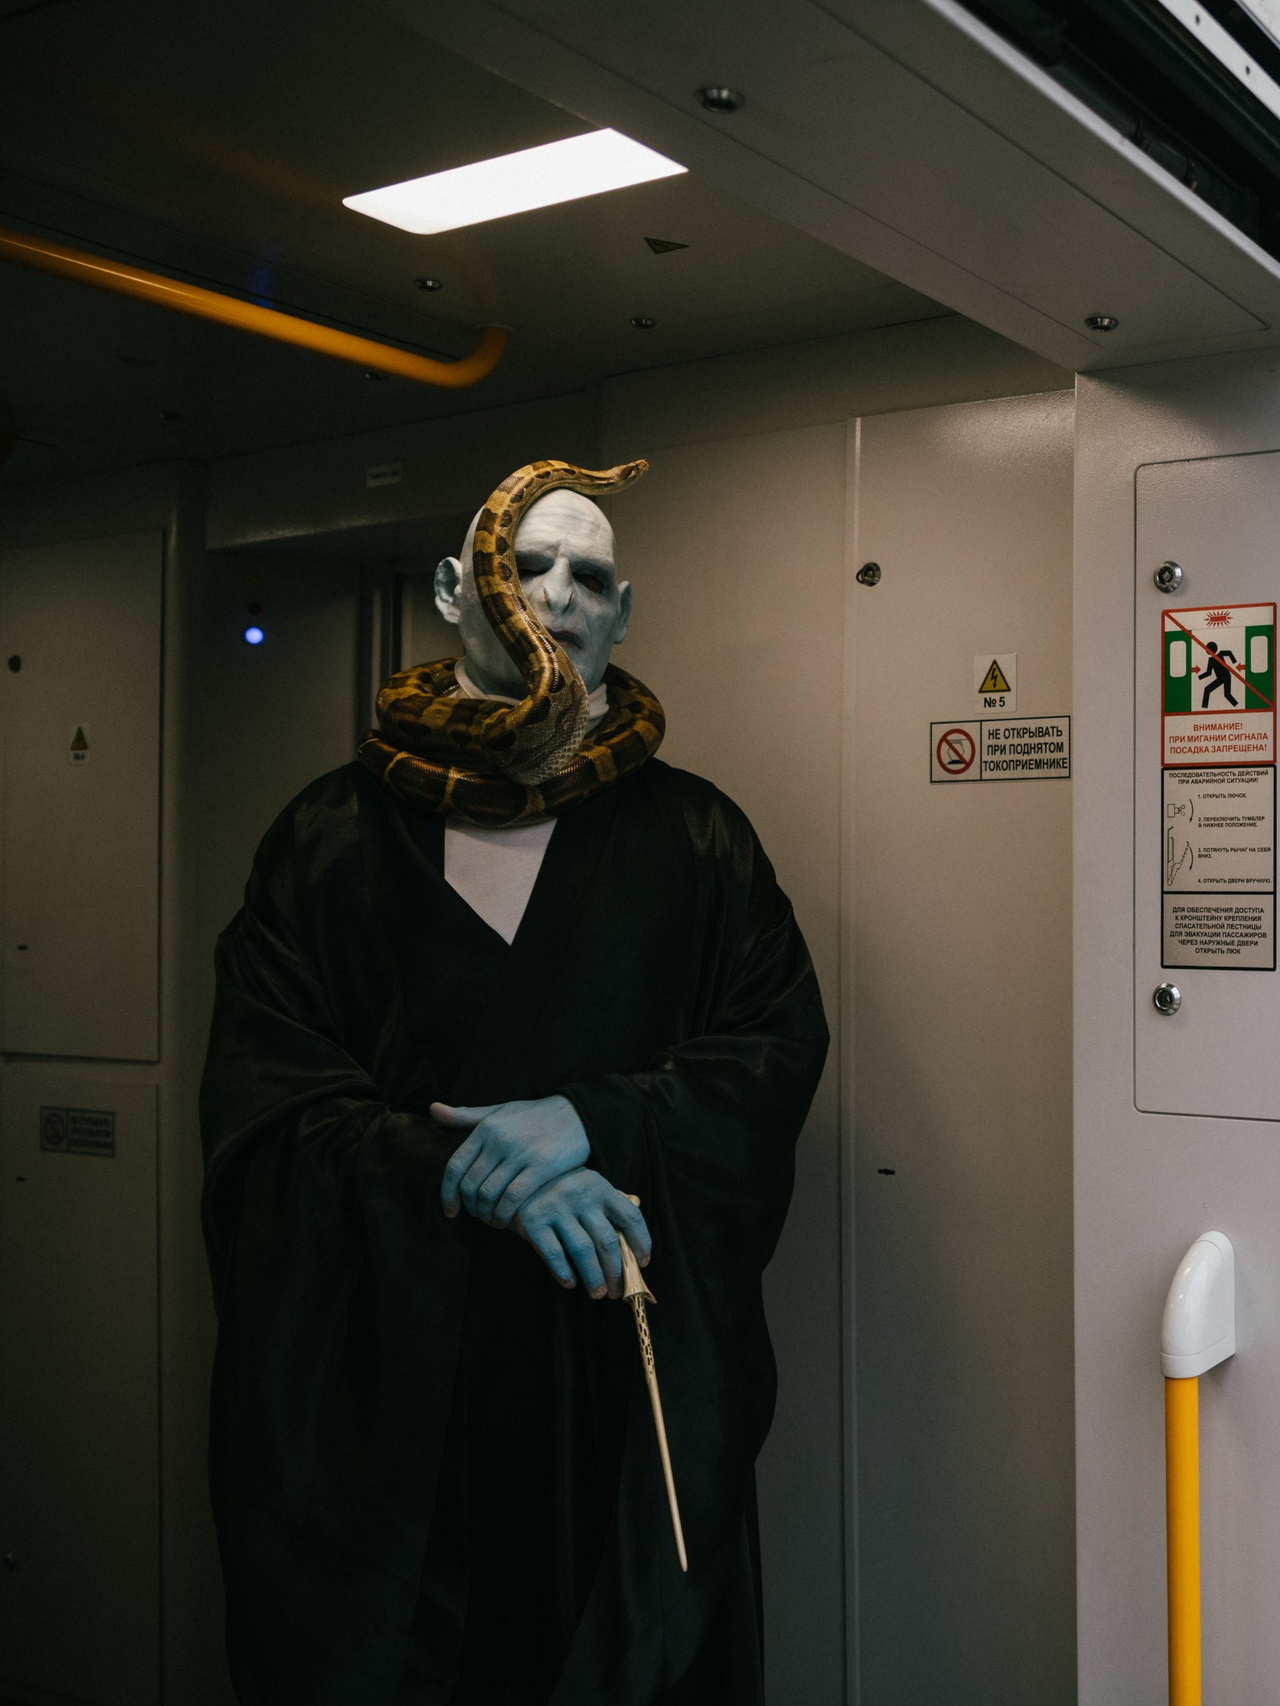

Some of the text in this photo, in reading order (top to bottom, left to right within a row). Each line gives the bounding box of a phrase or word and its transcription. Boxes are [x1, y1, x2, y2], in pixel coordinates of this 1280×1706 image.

[1194, 723, 1242, 731] ВНИМАНИЕ!
[988, 726, 1062, 740] НЕ ОТКРЫВАТЬ
[1228, 733, 1268, 741] СИГНАЛА
[987, 742, 1063, 756] ПРИ ПОДНЯТОМ
[1170, 744, 1266, 754] ПОСАДКА ЗАПРЕЩЕНА!
[983, 758, 1068, 771] ТОКОПРИЕМНИКЕ
